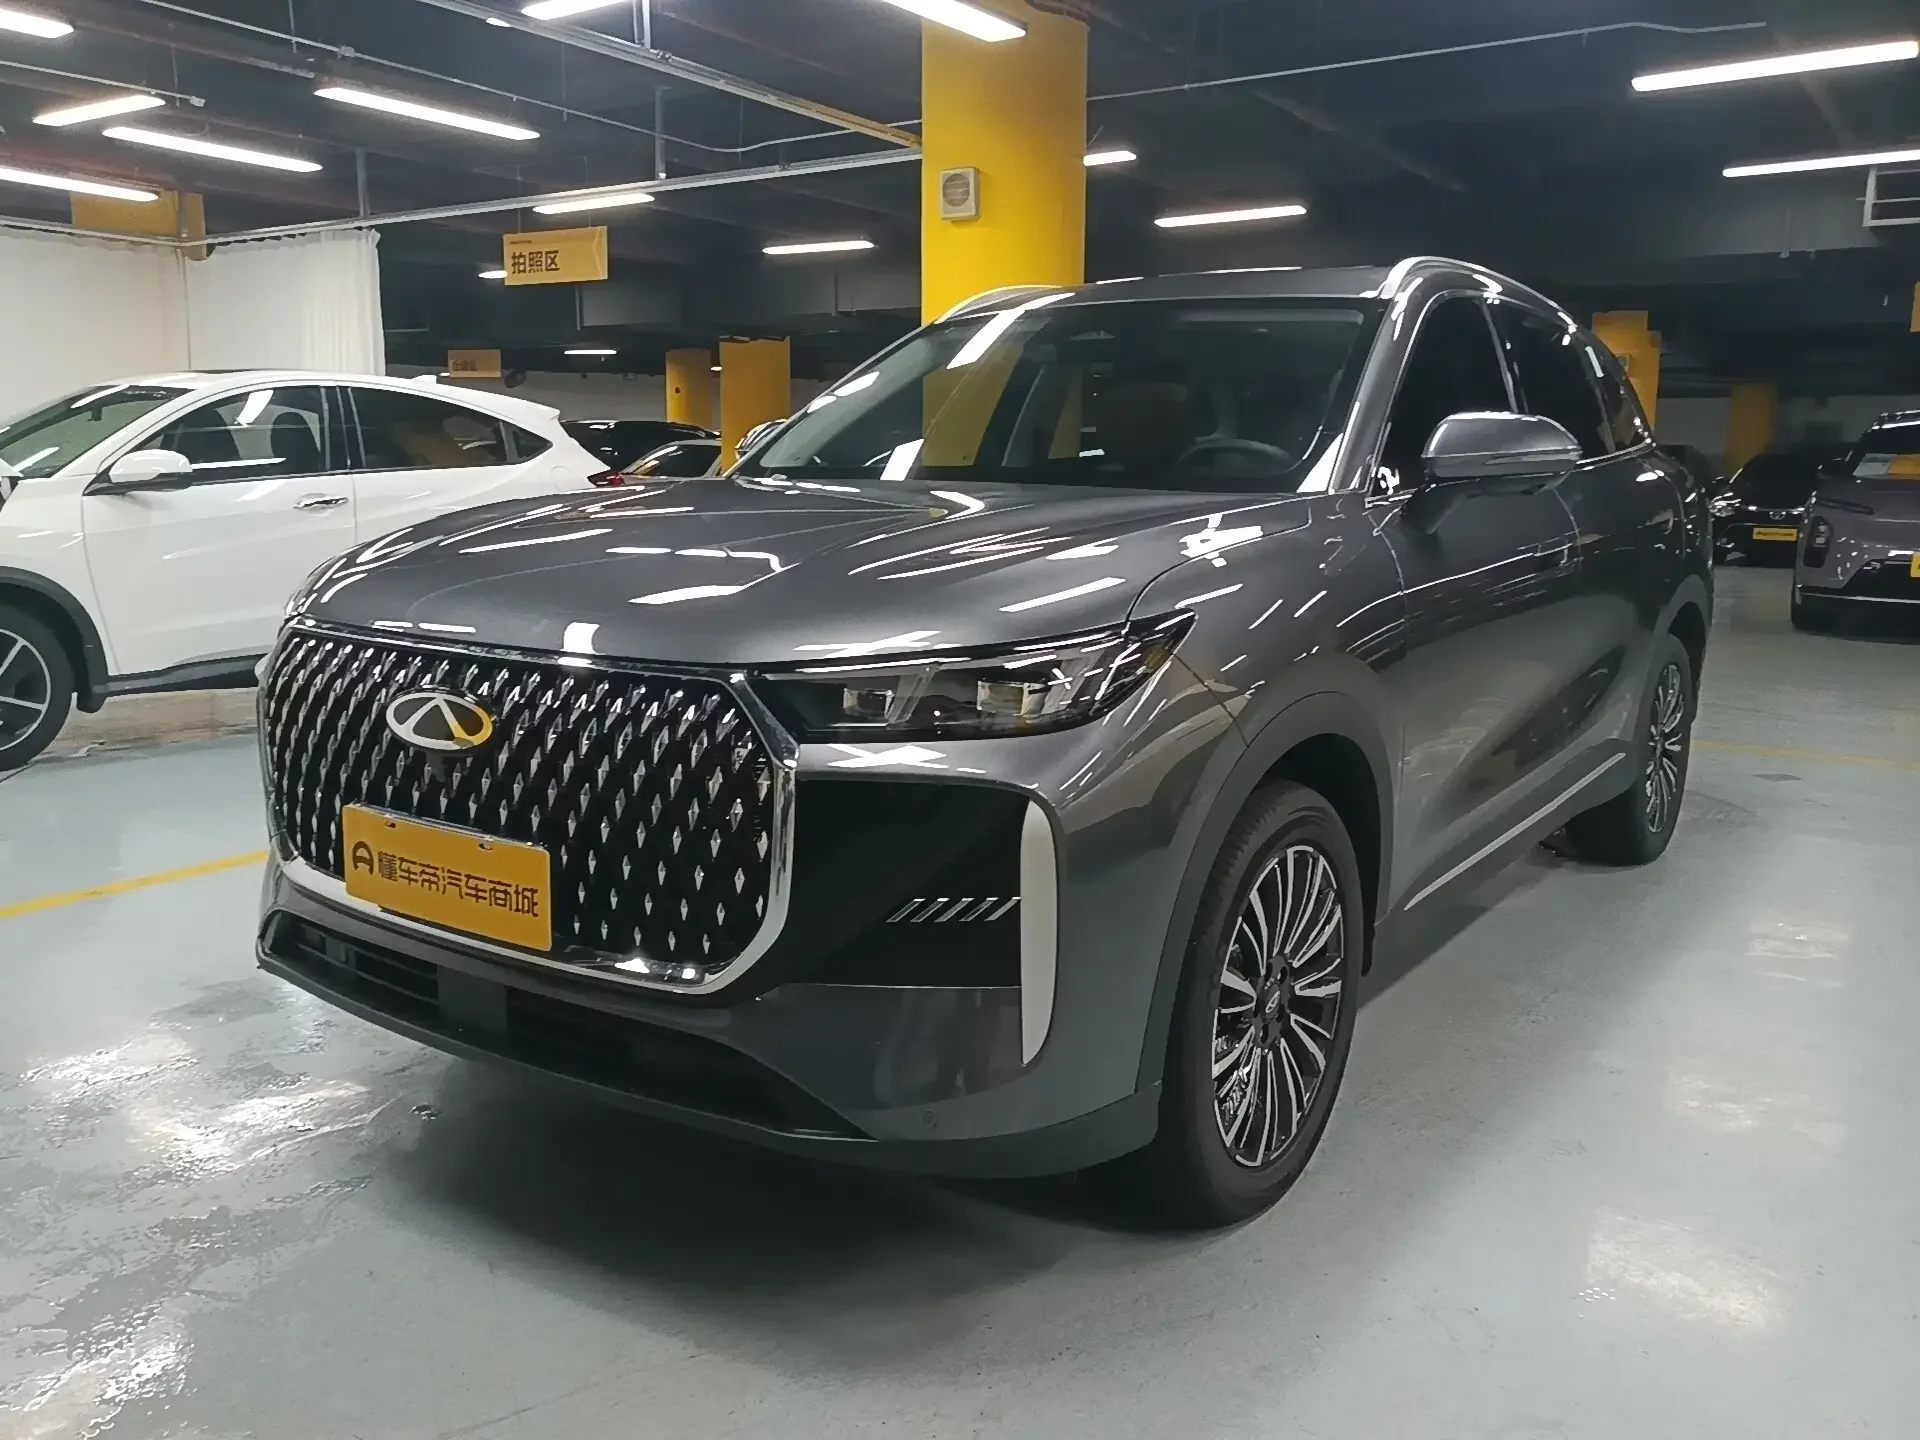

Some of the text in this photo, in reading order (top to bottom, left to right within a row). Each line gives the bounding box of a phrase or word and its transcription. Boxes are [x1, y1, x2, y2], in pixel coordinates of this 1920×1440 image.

[511, 250, 560, 275] 拍照区
[377, 850, 539, 918] 懂车帝汽车商城
